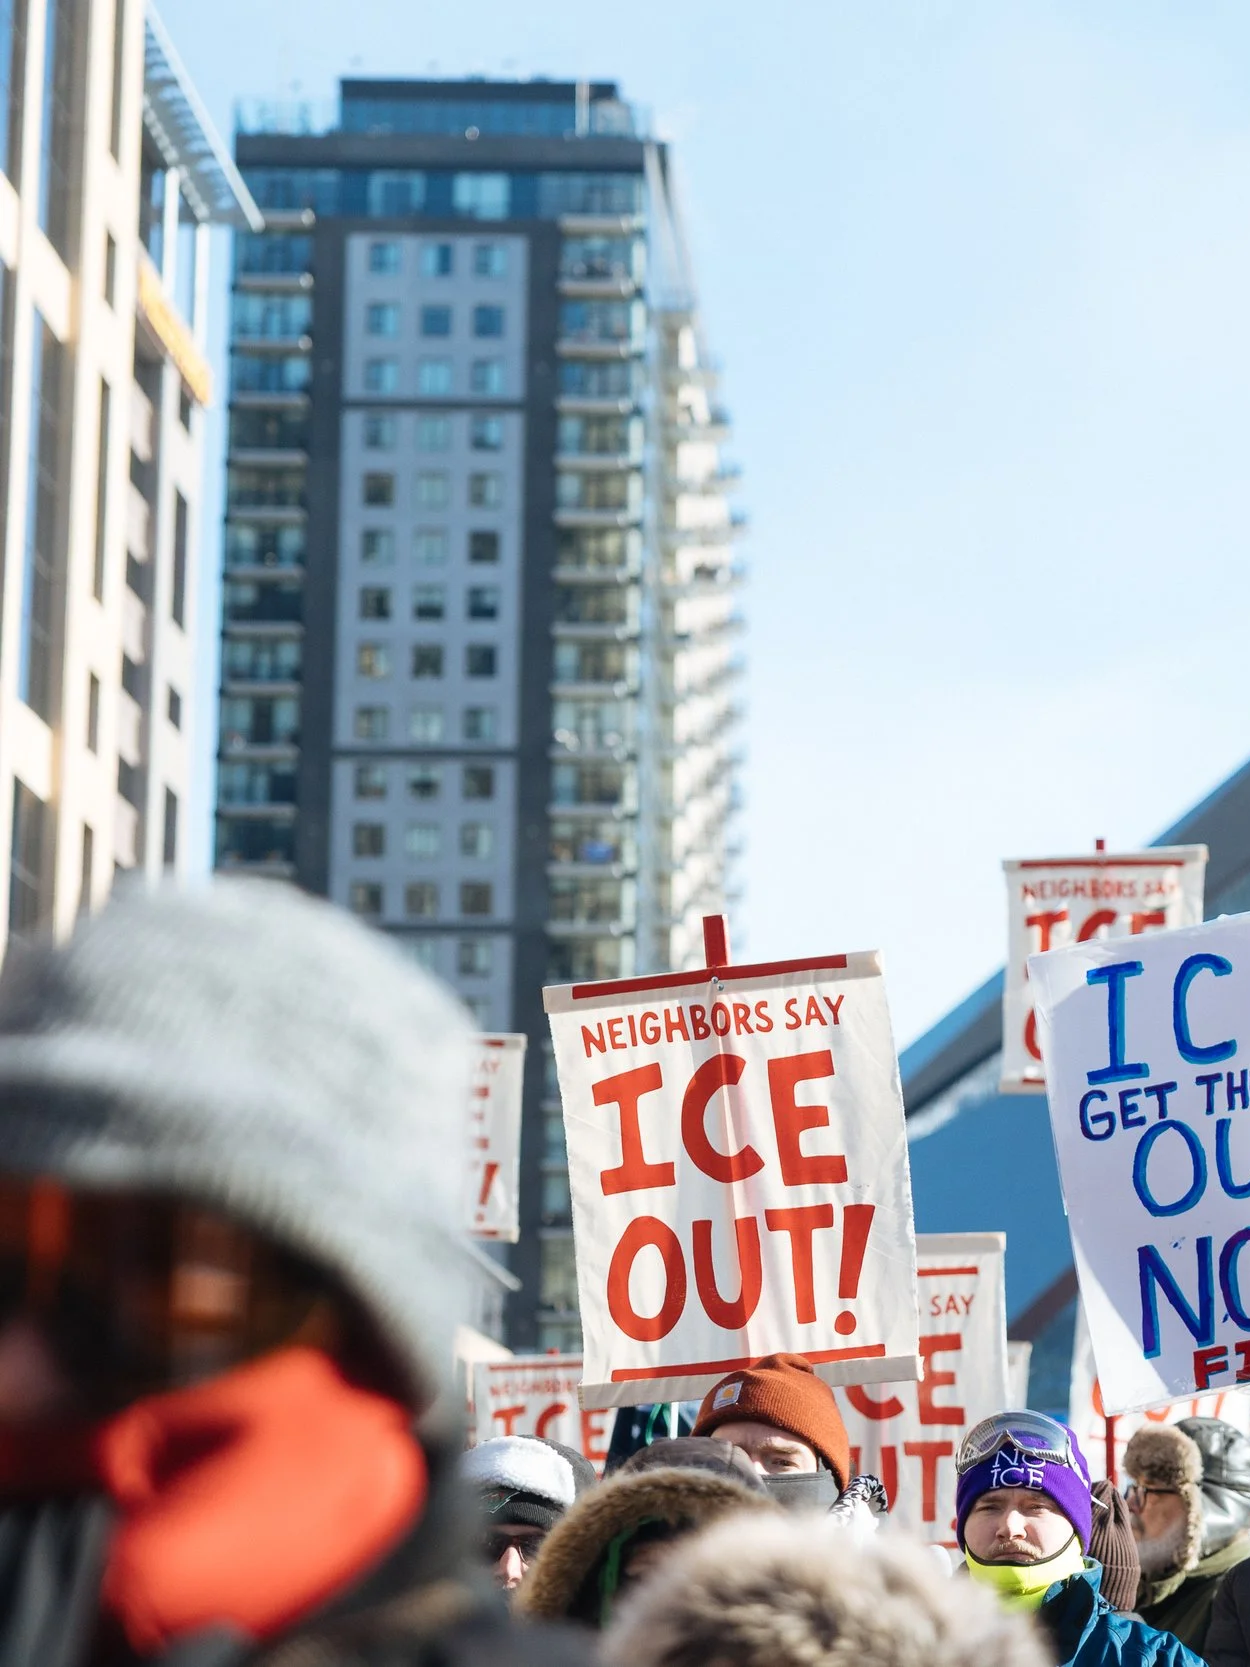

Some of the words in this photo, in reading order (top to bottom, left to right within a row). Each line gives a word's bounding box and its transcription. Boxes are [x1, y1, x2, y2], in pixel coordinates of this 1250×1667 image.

[1021, 877, 1137, 900] NEIGHBORS
[580, 1000, 775, 1058] NEIGHBORS
[784, 994, 846, 1028] SAY
[592, 1049, 849, 1196] ICE
[1079, 1081, 1178, 1142] GET
[606, 1203, 876, 1342] OUT!
[931, 1294, 975, 1317] SAY
[990, 1467, 1044, 1490] ICE
